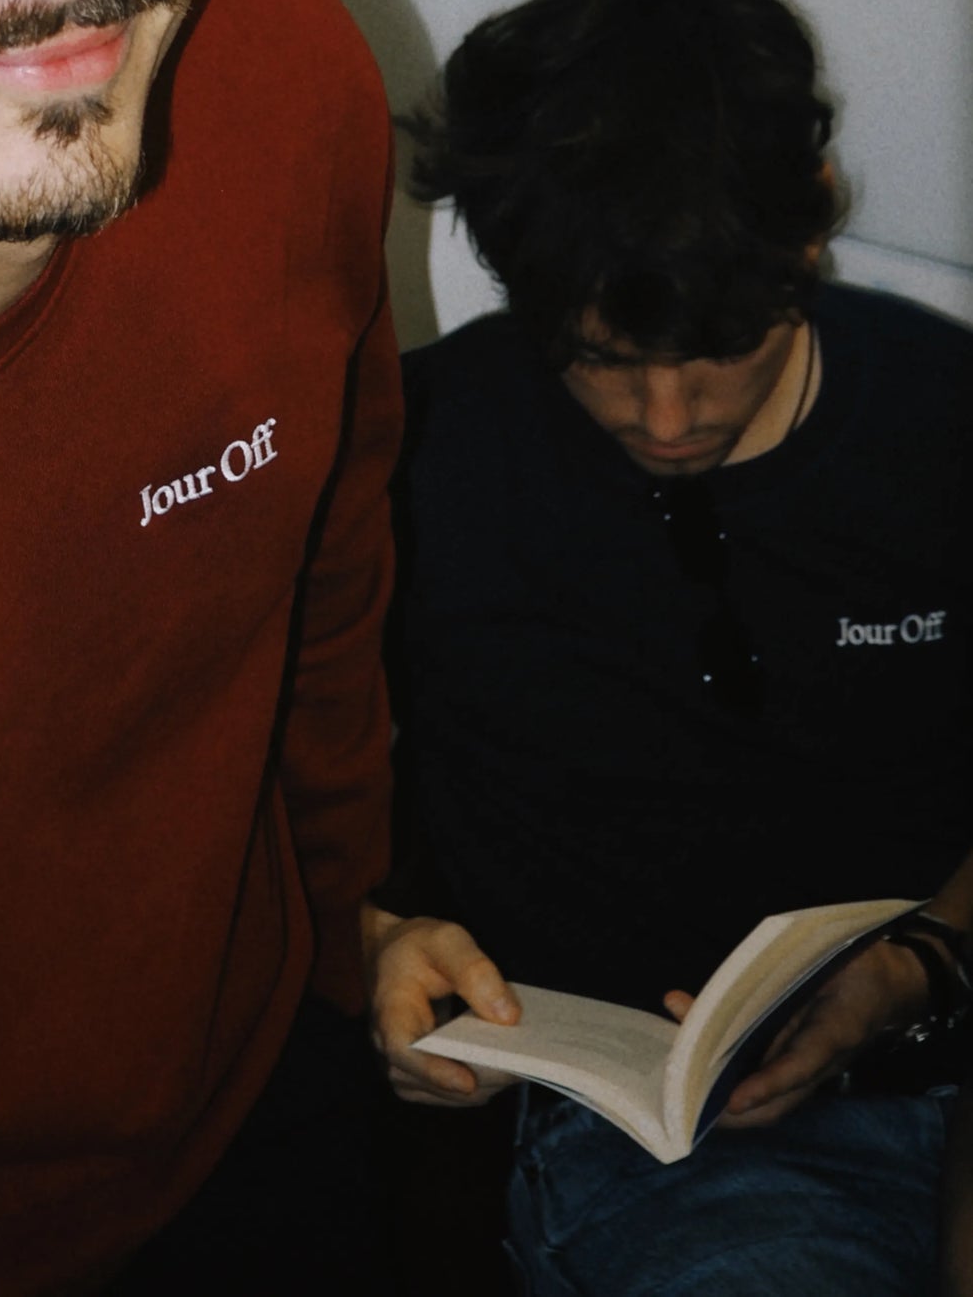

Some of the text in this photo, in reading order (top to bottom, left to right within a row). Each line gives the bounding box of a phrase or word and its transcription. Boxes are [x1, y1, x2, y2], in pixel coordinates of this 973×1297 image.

[139, 417, 278, 527] Jour Off
[836, 610, 947, 646] Jour Off
